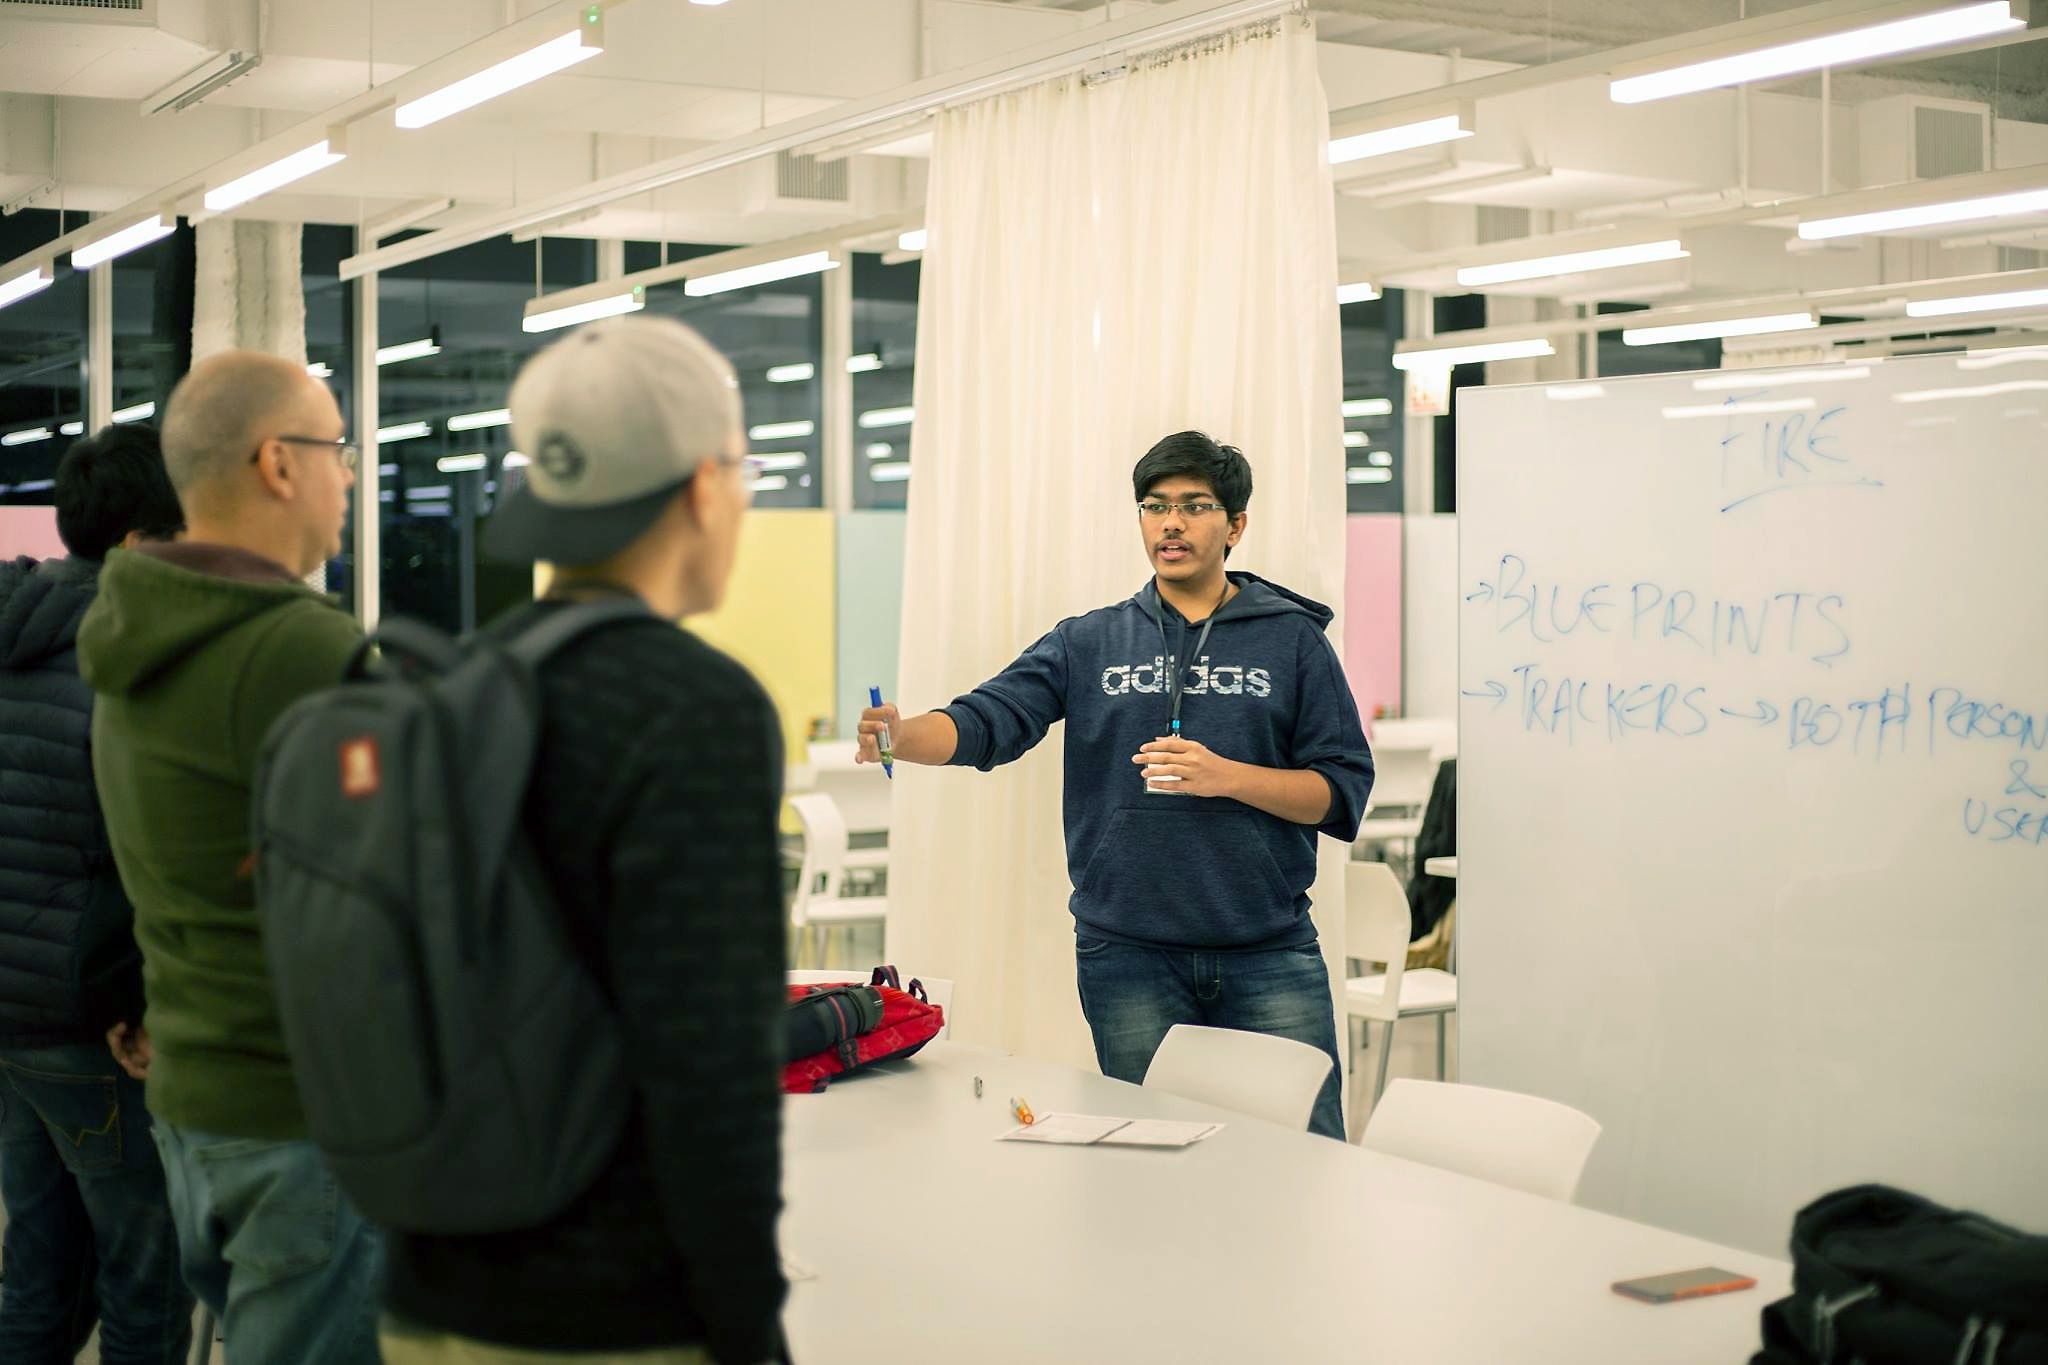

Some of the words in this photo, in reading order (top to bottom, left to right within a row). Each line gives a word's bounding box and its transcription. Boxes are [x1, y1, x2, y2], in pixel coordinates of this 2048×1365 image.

[1720, 391, 1850, 489] FIRE
[1498, 553, 1850, 669] BLUEPRINTS
[1101, 655, 1272, 698] adidas
[1513, 663, 1708, 746] TRACKERS
[1786, 683, 1912, 762] BOTH
